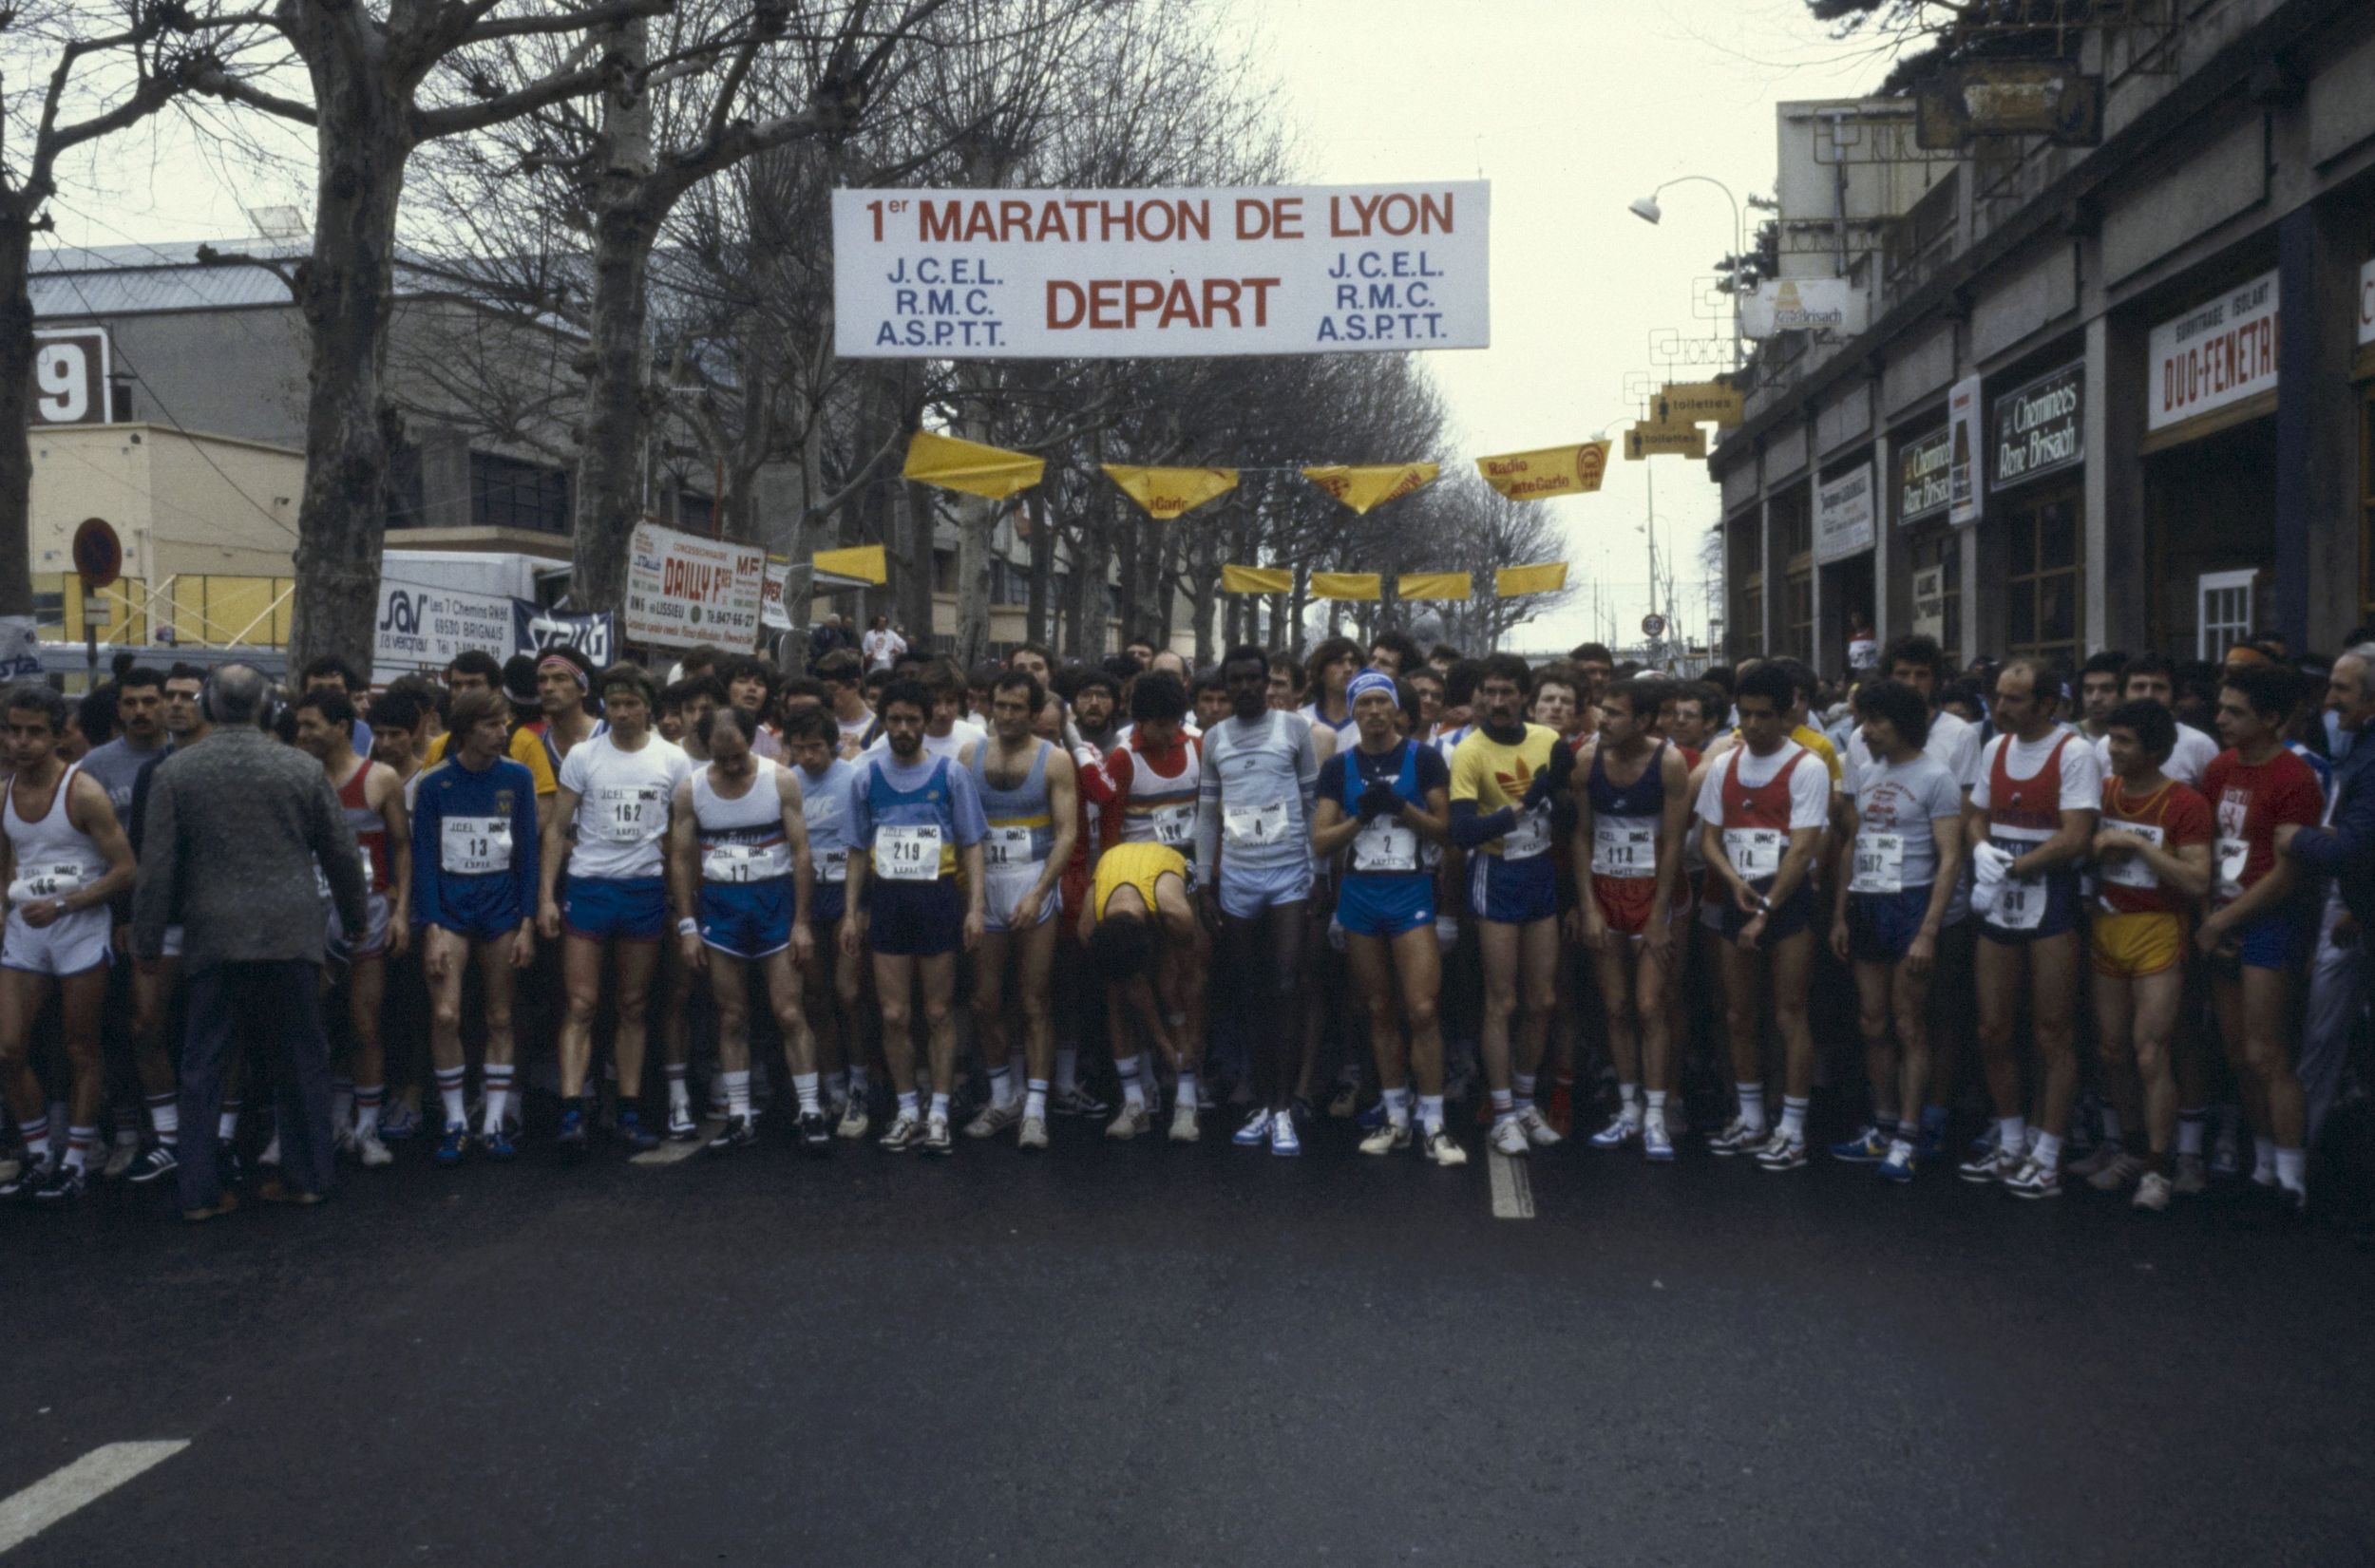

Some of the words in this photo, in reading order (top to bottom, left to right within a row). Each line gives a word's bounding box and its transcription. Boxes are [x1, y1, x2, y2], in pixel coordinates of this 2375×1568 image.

[919, 198, 1210, 242] MARATHON
[1235, 197, 1304, 239] DE
[1329, 192, 1454, 236] LYON
[886, 257, 1004, 285] J.C.E.L.
[1327, 252, 1444, 278] J.C.E.L.
[897, 290, 994, 315] R.M.C.
[1045, 277, 1282, 330] DEPART
[1336, 283, 1435, 309] R.M.C.
[37, 343, 88, 422] 9
[1673, 398, 1732, 410] toilettes
[1645, 433, 1697, 444] toilettes
[1488, 457, 1528, 476] Radio
[664, 557, 711, 602] DAILLY
[453, 600, 487, 619] Chemins
[464, 622, 504, 641] BRIGNAIS
[1645, 619, 1660, 631] 60
[616, 803, 641, 822] 162
[470, 839, 487, 857] 13
[894, 841, 920, 860] 219
[1384, 835, 1392, 854] 2
